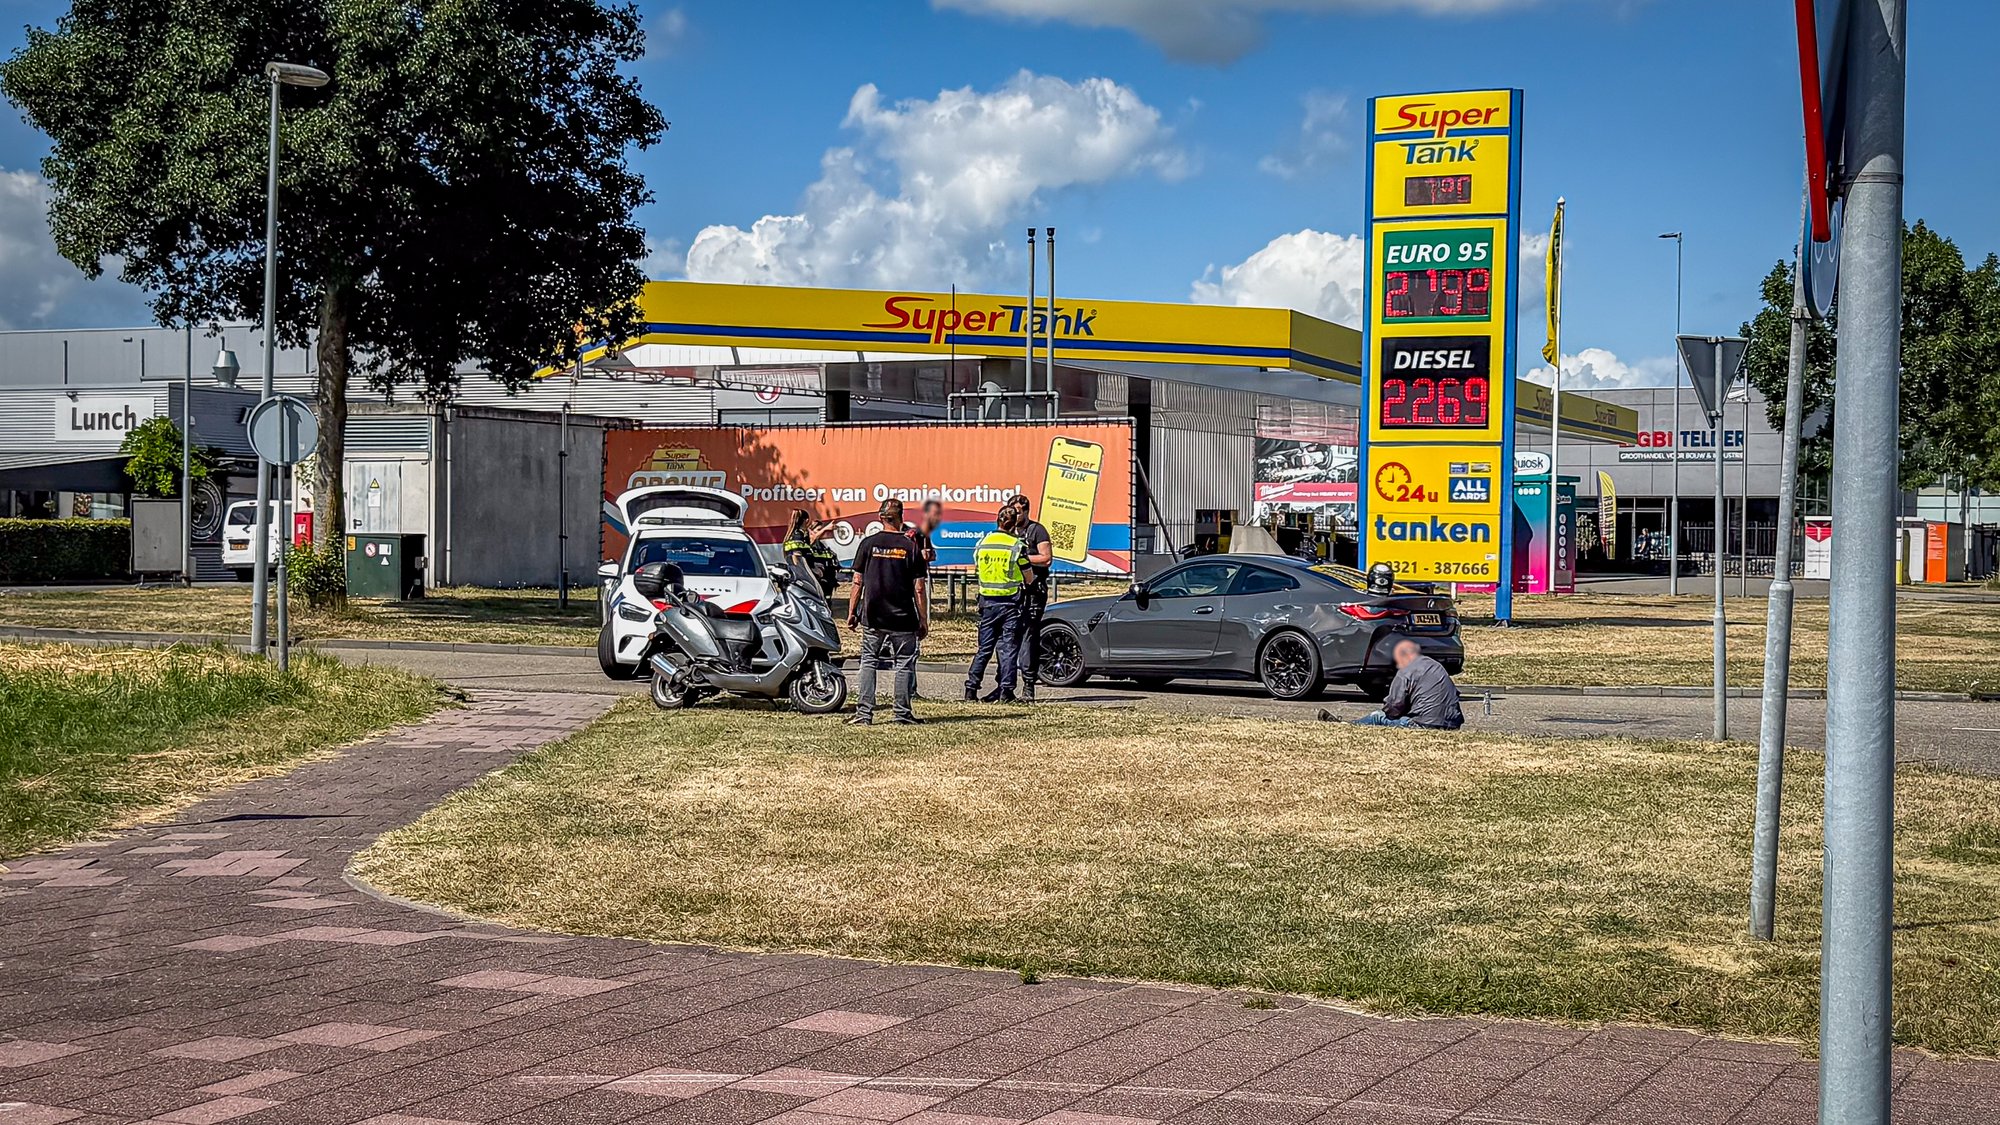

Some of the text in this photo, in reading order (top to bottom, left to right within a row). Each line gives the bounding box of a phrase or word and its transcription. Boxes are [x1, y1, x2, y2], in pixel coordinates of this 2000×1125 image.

[1382, 103, 1499, 138] Super
[1398, 139, 1479, 164] Tank
[1387, 242, 1488, 264] EURO 95
[1394, 350, 1475, 369] DIESEL
[72, 405, 136, 430] Lunch
[1620, 431, 1673, 447] GBI
[1055, 454, 1096, 470] Super
[1514, 455, 1544, 469] uiosk
[1059, 469, 1087, 482] Tank
[741, 484, 826, 503] Profiteer
[831, 488, 866, 502] van
[1454, 480, 1487, 492] ALL
[1452, 492, 1487, 500] CARDS
[1375, 514, 1490, 543] tanken
[1433, 562, 1490, 575] 387666
